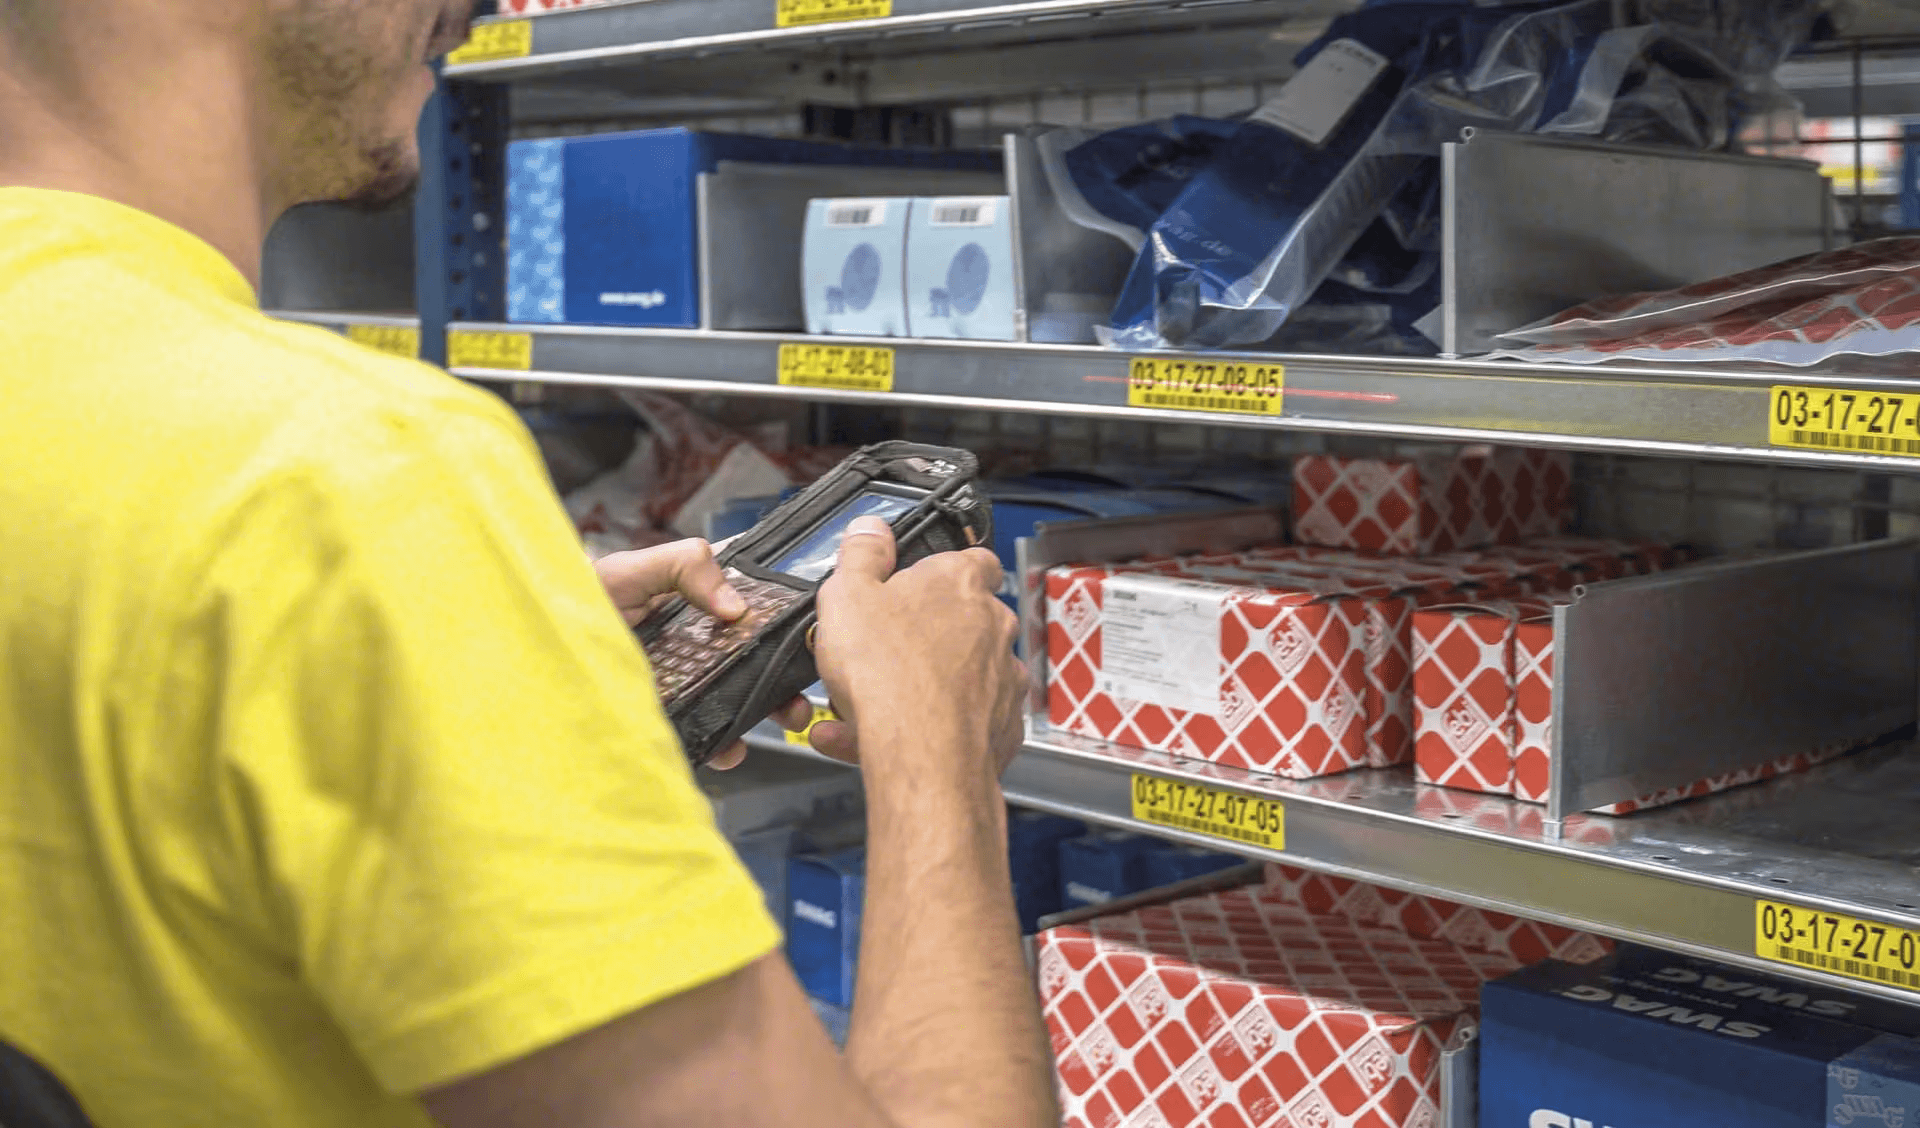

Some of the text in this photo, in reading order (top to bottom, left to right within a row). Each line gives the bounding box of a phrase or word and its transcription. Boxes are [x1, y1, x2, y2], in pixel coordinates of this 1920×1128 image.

[1133, 361, 1279, 397] 03-17-27-08-05
[1776, 390, 1920, 435] 03-17-27-
[1135, 775, 1280, 833] 03-17-27-07-05
[1762, 905, 1920, 969] 03-17-27-0
[1562, 984, 1772, 1038] SWAG
[1654, 967, 1857, 1016] SWAG
